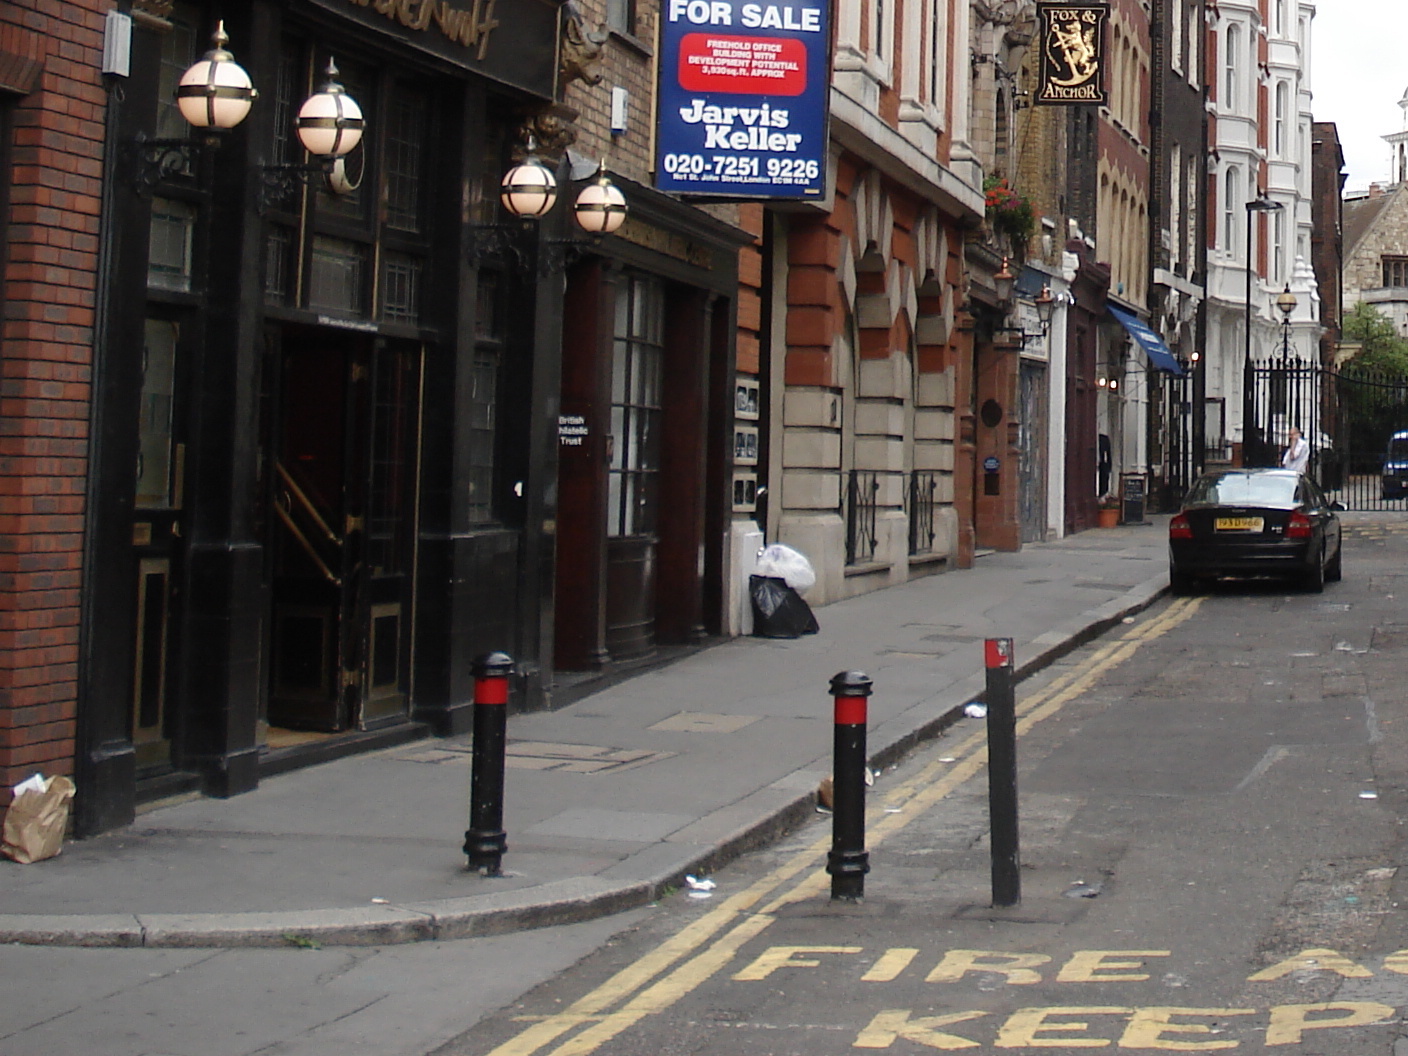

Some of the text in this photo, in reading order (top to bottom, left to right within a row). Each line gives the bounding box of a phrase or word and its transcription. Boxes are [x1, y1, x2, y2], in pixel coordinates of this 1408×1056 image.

[741, 4, 820, 32] SALE
[1050, 10, 1096, 24] FOX &
[707, 39, 782, 52] FREEHOLD OFFICE
[713, 49, 776, 60] BUILDING WITH
[688, 55, 799, 71] DEVELOPMENT POTENTIAL
[750, 70, 785, 78] APPROX
[1043, 83, 1096, 98] ANCHOR
[680, 99, 789, 128] Jarvis
[704, 124, 802, 152] Keller
[664, 153, 819, 179] 020-7251 9226
[559, 426, 588, 435] hilatelic
[561, 436, 582, 445] Trust
[731, 945, 1171, 983] FIRE
[852, 999, 1397, 1051] KEEP
